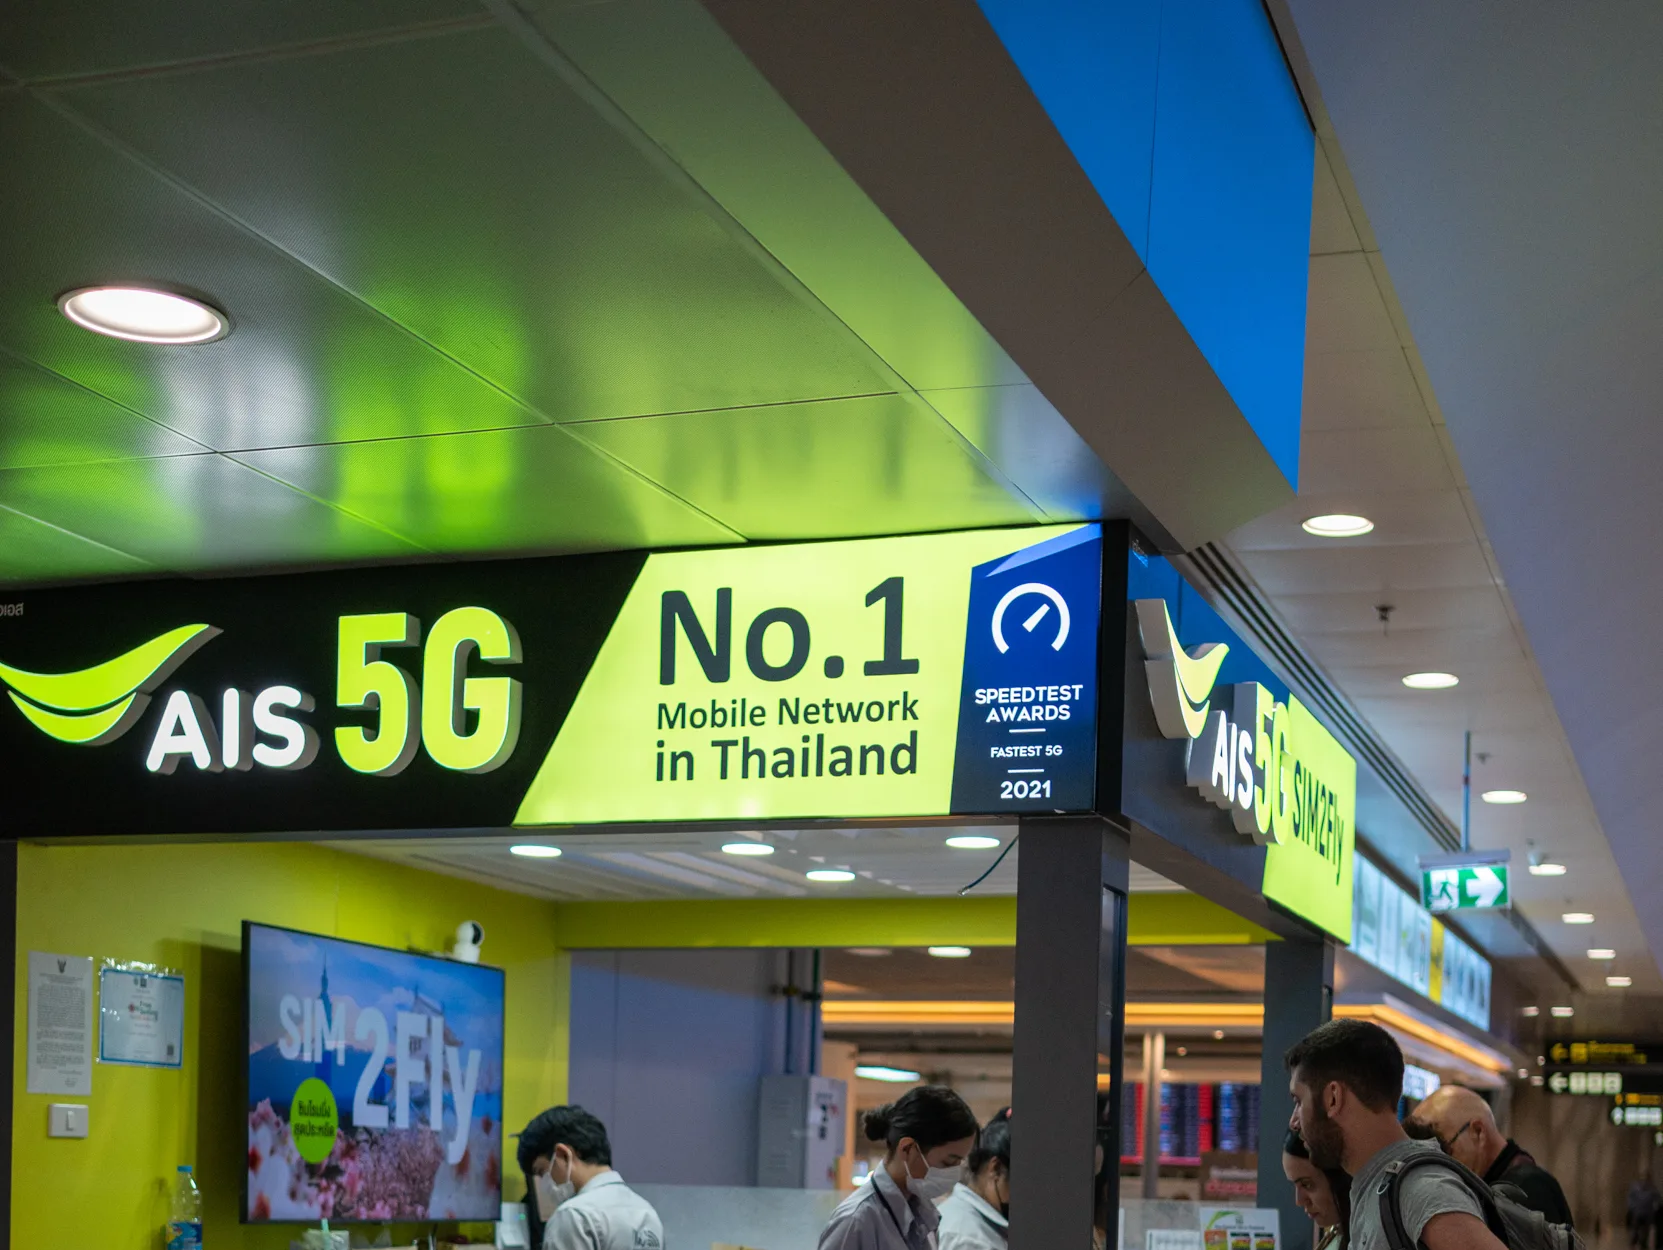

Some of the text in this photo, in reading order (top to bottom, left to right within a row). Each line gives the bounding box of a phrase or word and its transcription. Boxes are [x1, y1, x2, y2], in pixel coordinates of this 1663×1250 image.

[659, 576, 920, 686] No.1
[146, 606, 520, 775] AIS 5G
[656, 691, 919, 730] Mobile Network
[974, 684, 1084, 705] SPEEDTEST
[985, 704, 1071, 723] AWARDS
[655, 730, 918, 781] in Thailand
[990, 744, 1063, 758] FASTEST 5G
[1211, 681, 1292, 846] AIS 5G
[1000, 780, 1051, 799] 2021
[1291, 759, 1344, 886] SIM2Fly
[278, 993, 346, 1067] SIM
[353, 1006, 482, 1166] 2Fly
